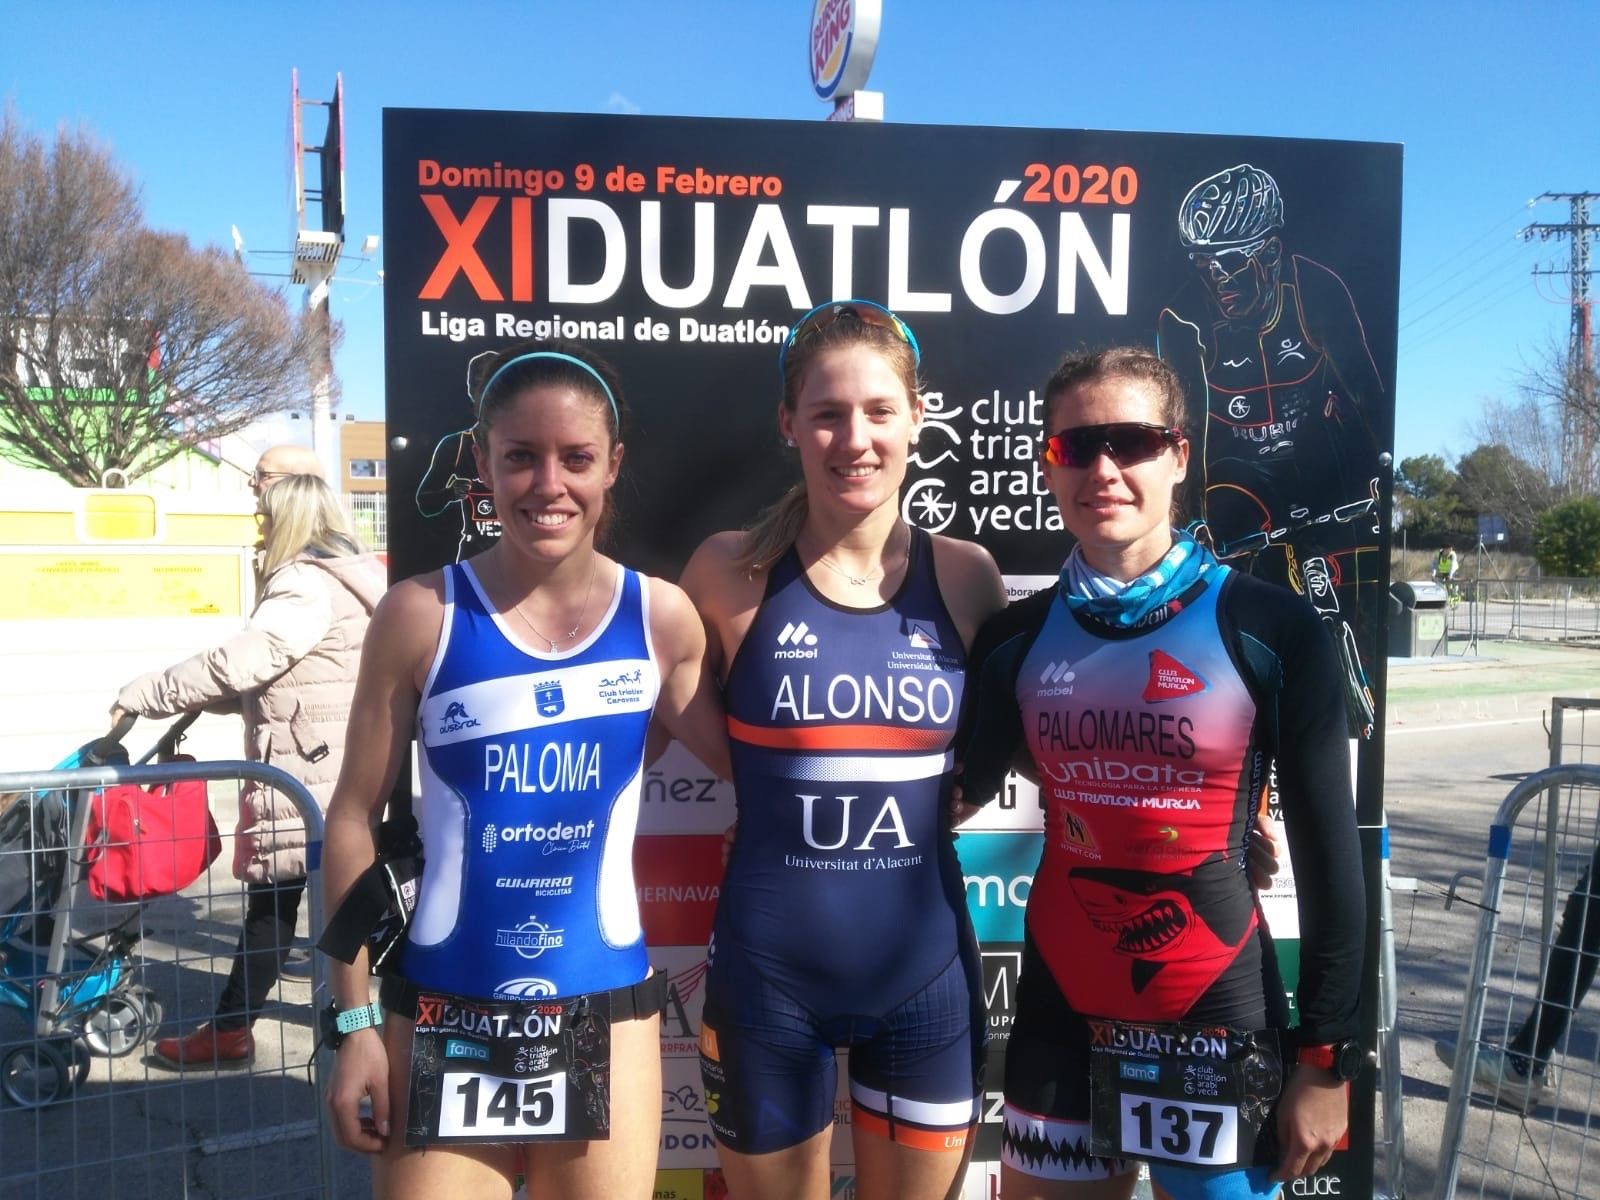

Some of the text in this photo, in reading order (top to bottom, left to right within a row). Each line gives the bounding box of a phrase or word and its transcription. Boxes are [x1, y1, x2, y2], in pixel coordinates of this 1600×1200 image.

[418, 159, 783, 197] Domingo 9 de Febrero
[1023, 163, 1138, 205] 2020
[546, 180, 1131, 316] DUATLÓN
[421, 310, 790, 344] Liga Regional de Duatlón
[971, 389, 1045, 426] club
[969, 460, 1050, 496] arab
[969, 495, 1065, 536] yecla
[774, 648, 818, 660] mobel
[770, 673, 954, 724] ALONSO
[1037, 685, 1074, 698] mobel
[1037, 709, 1196, 760] PALOMARES
[484, 741, 601, 794] PALOMA
[644, 771, 717, 803] ñez
[1076, 791, 1139, 807] TRIATLON
[1141, 797, 1202, 810] MURCIA
[501, 820, 595, 842] ortodent
[795, 794, 916, 851] UA
[785, 854, 924, 871] Universitat d'Alacant
[495, 877, 574, 889] GUIJARRO
[535, 887, 573, 897] BICICLETAS
[537, 1005, 563, 1015] 2020
[450, 1042, 488, 1059] fama
[529, 1044, 547, 1054] club
[1123, 1065, 1157, 1081] fama
[1196, 1066, 1214, 1074] club
[456, 1077, 554, 1129] 145
[1130, 1101, 1224, 1159] 137
